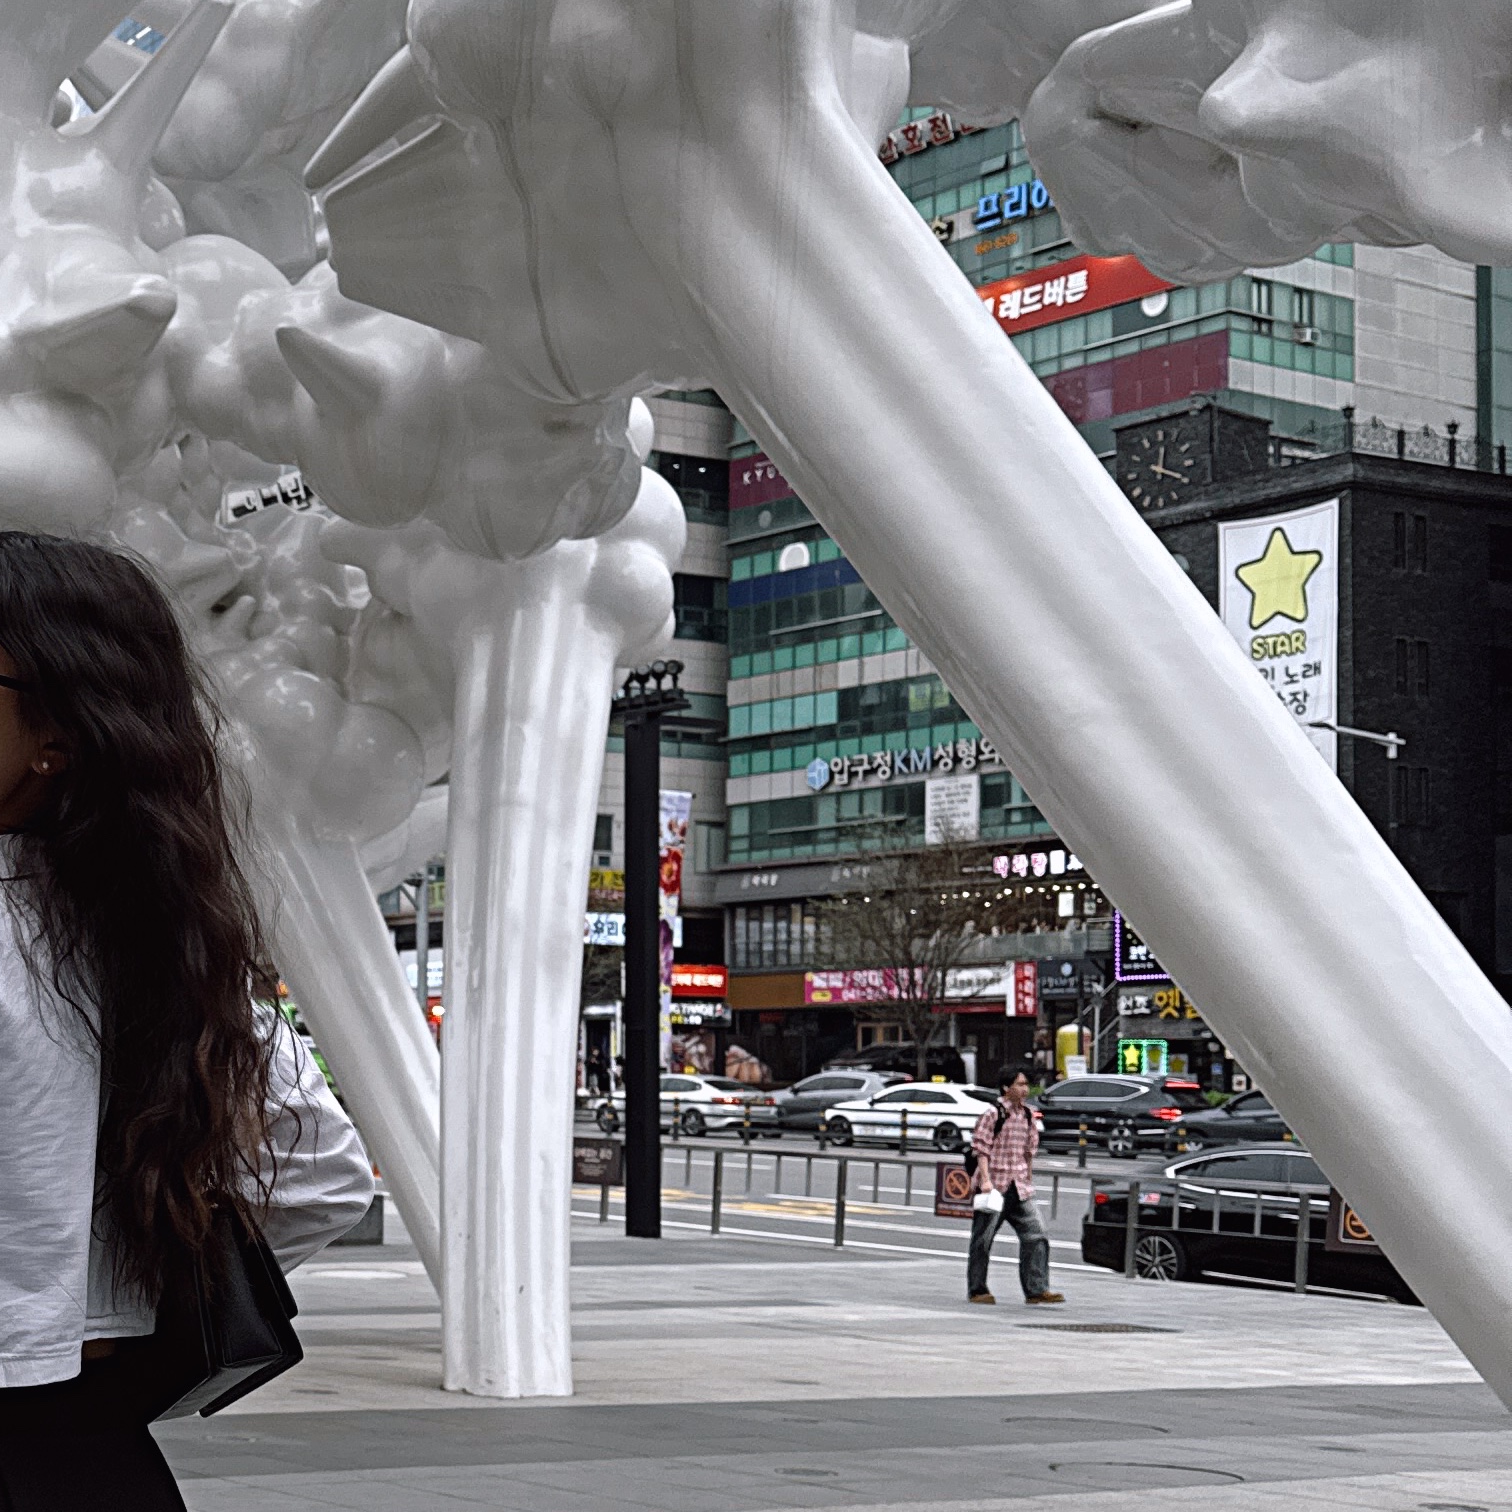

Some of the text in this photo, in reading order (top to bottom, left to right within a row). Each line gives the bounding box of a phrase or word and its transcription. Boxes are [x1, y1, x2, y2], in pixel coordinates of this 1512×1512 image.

[998, 269, 1088, 319] 레드버튼
[1251, 629, 1308, 661] STAR
[1283, 661, 1322, 685] 노래
